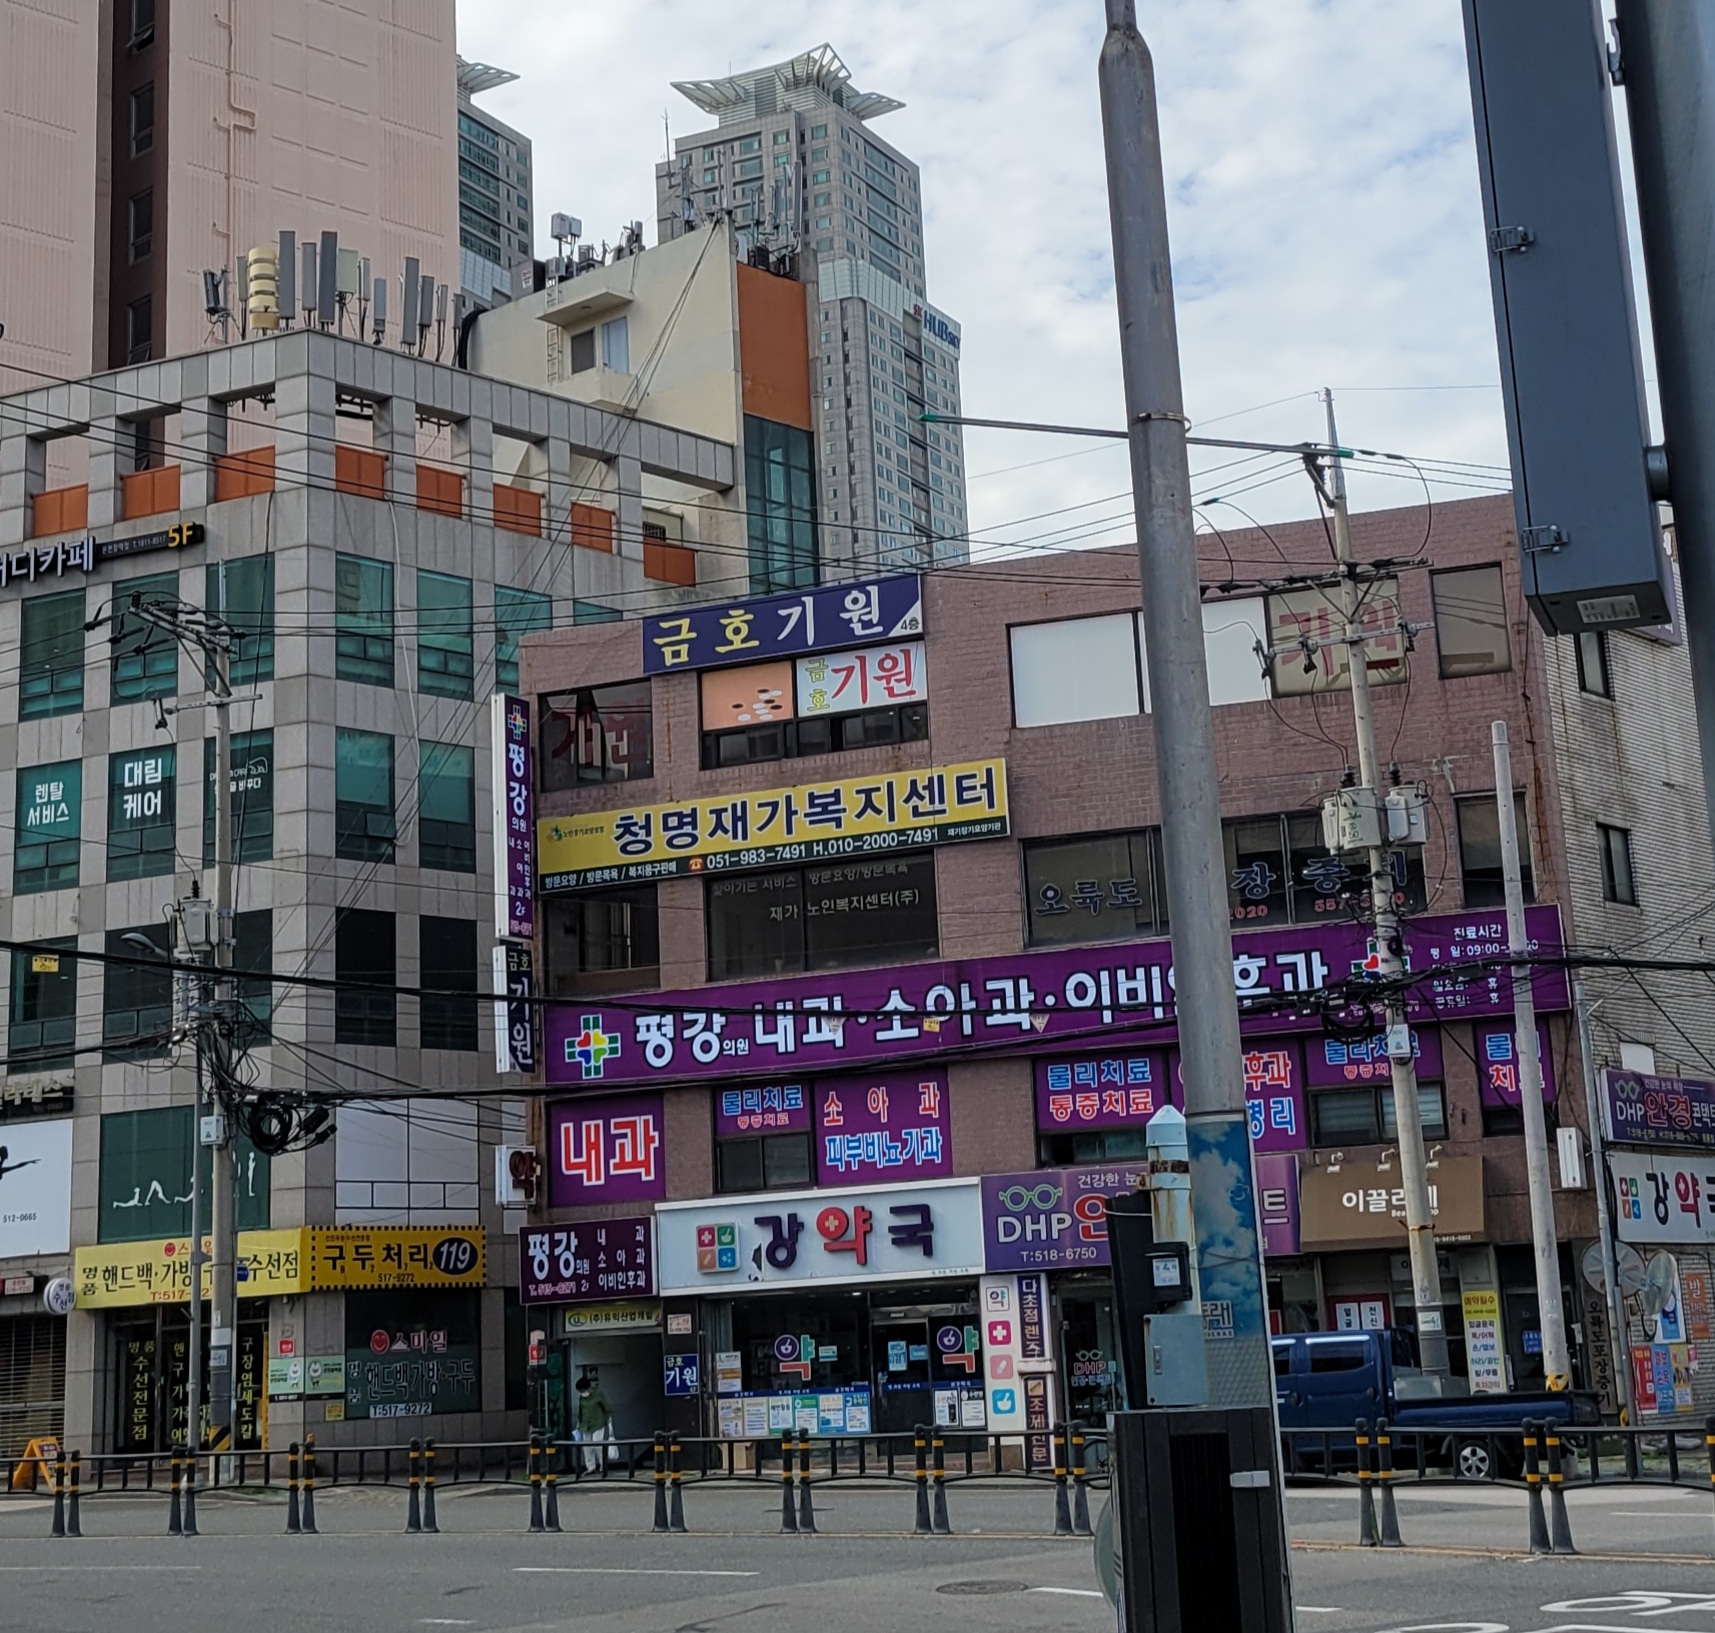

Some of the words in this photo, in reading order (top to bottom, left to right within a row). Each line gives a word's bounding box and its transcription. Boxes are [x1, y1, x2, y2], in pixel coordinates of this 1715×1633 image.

[923, 309, 949, 342] HUB
[168, 522, 195, 548] 5F
[653, 608, 760, 667] 금호
[777, 585, 885, 647] 기원
[805, 658, 831, 712] 금호
[831, 648, 917, 706] 기원
[124, 758, 162, 788] 대림
[508, 742, 528, 817] 평강
[35, 781, 64, 804] 렌탈
[123, 790, 162, 819] 케어
[26, 803, 70, 827] 서비스
[613, 766, 997, 857] 청명재가복지센터
[706, 845, 806, 869] 051-983-7491
[813, 827, 939, 857] H.010-2000-7491
[545, 873, 577, 889] 방문요양
[586, 868, 619, 884] 방문목욕
[762, 876, 798, 892] 서비스
[770, 904, 799, 922] 재가
[806, 888, 920, 917] 노인복지센터(주)
[1034, 883, 1142, 916] 오륙도
[1453, 924, 1503, 941] 진료시간
[507, 951, 531, 972] 금호
[509, 977, 533, 1065] 기원
[636, 1011, 728, 1069] 평강
[722, 1038, 750, 1056] 의원
[1047, 1058, 1152, 1090] 물리치료
[722, 1085, 804, 1116] 물리치료
[1049, 1089, 1154, 1122] 통증치료
[1616, 1101, 1645, 1122] DHP
[1643, 1091, 1692, 1130] 안경
[560, 1115, 660, 1187] 내과
[825, 1126, 942, 1172] 피부비뇨기과
[1077, 1172, 1120, 1189] 건강한
[753, 1203, 935, 1269] 강약국
[997, 1214, 1073, 1243] DHP
[323, 1243, 429, 1271] 구두처리
[439, 1240, 472, 1270] 119
[528, 1231, 579, 1281] 평강
[575, 1258, 590, 1275] 의원
[1020, 1246, 1097, 1263] T:518-6750
[82, 1265, 99, 1297] 명품
[377, 1273, 415, 1283] 517-9272
[598, 1270, 646, 1291] 이비인후과
[392, 1330, 448, 1354] 스마일
[665, 1365, 699, 1388] 기원
[131, 1356, 150, 1440] 수선전문점
[372, 1402, 432, 1417] T:517-9272
